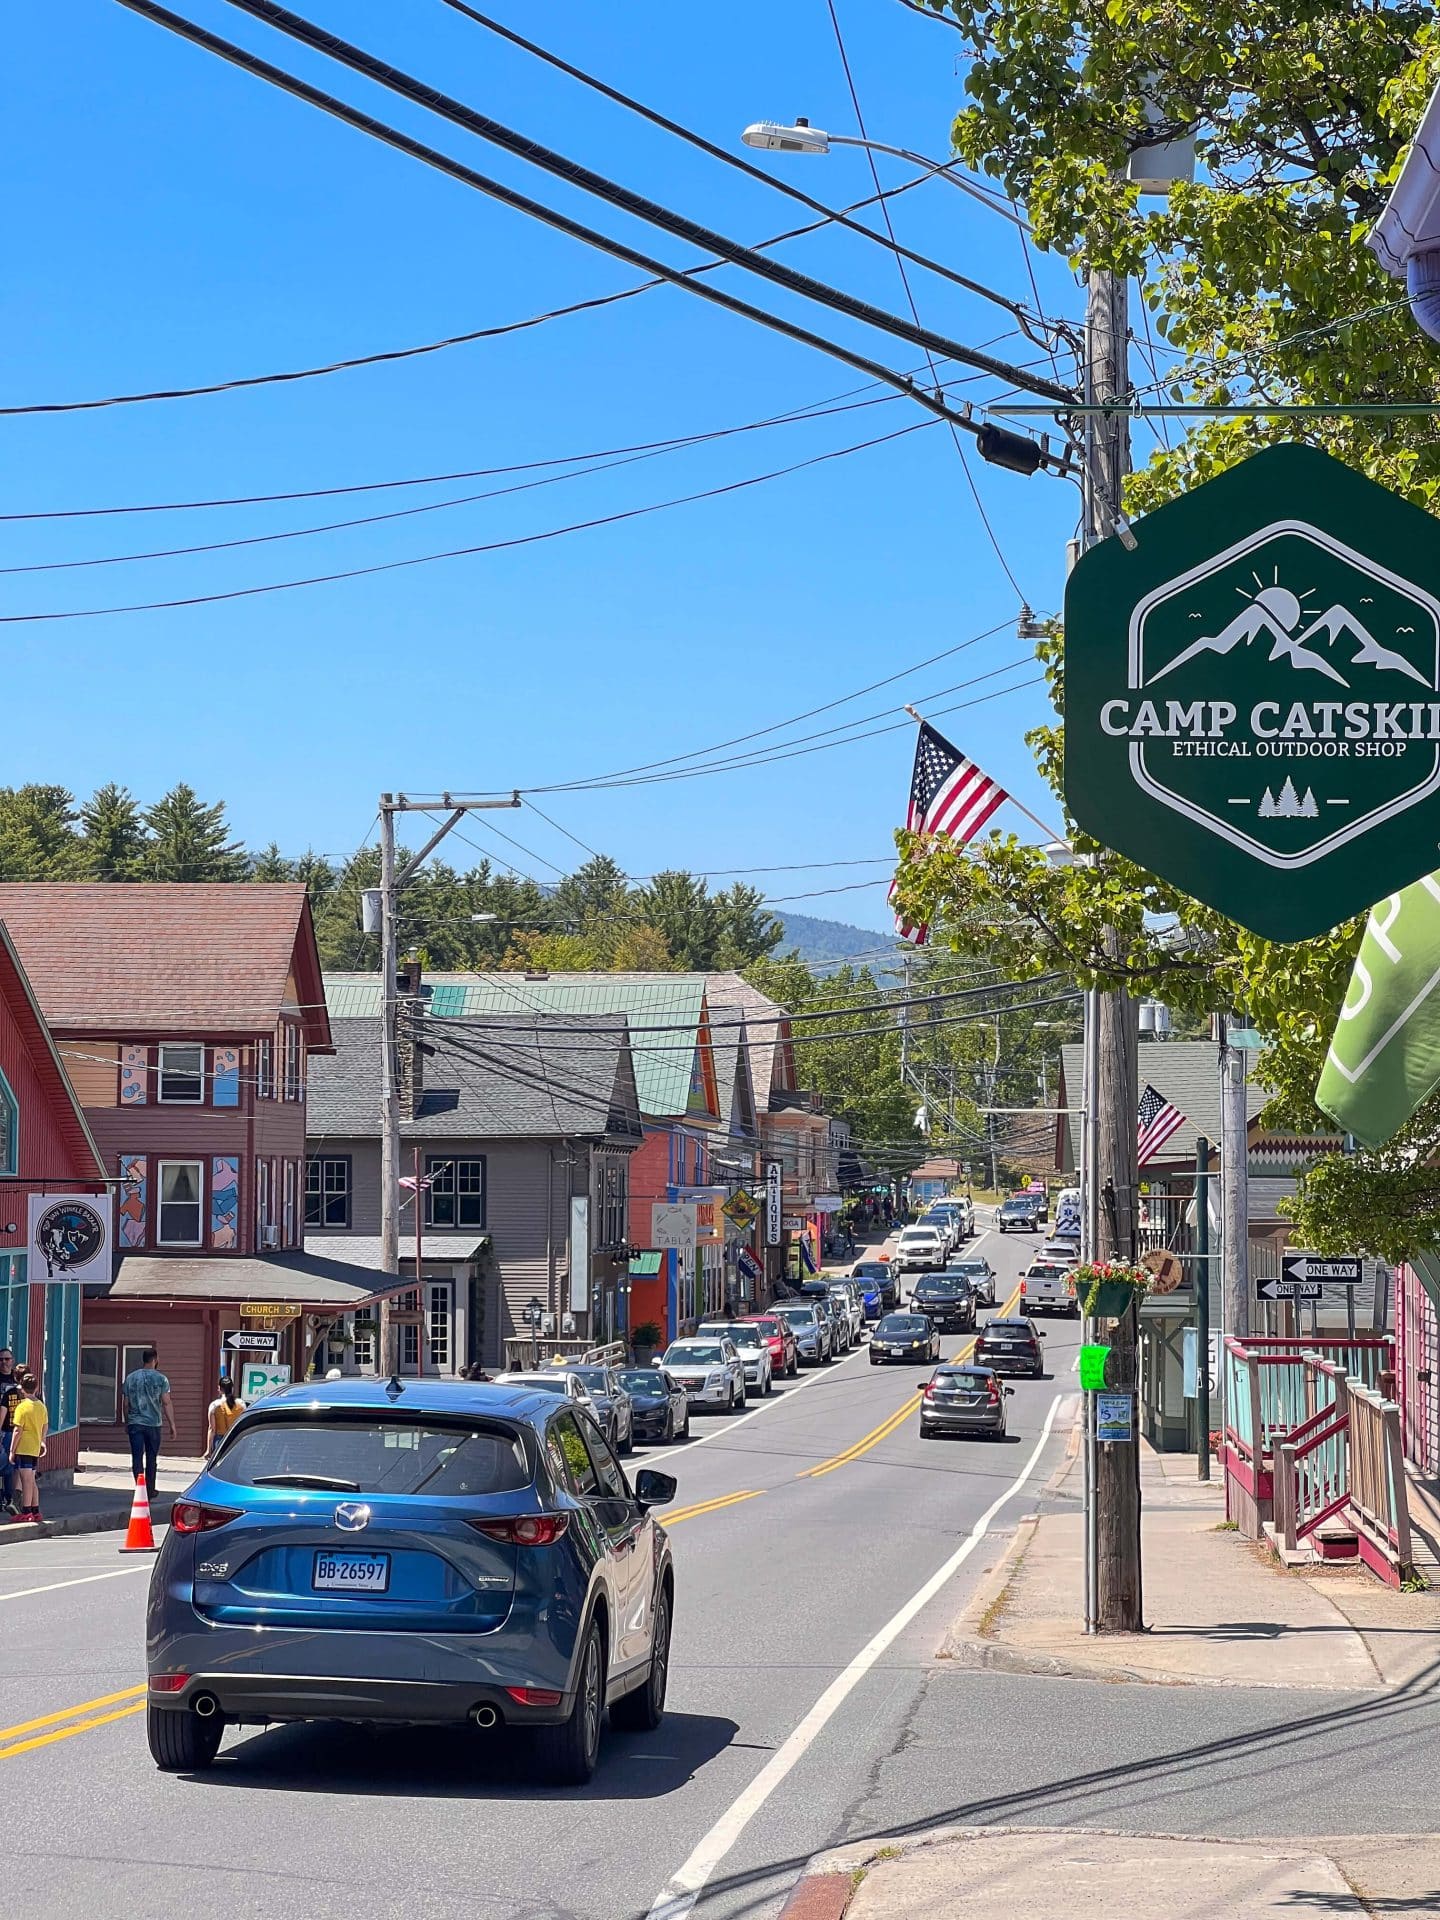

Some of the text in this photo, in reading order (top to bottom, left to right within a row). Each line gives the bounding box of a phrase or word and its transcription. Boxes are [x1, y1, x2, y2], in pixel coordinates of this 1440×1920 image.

[1099, 699, 1237, 737] CAMP
[1172, 741, 1407, 758] ETHICAL OUTDOOR SHOP
[770, 1165, 778, 1243] ANTIQUES
[656, 1236, 692, 1245] TABLA
[1306, 1264, 1355, 1276] ONE WAY
[1276, 1284, 1295, 1294] ONE
[246, 1305, 280, 1314] CHURCH
[239, 1336, 274, 1345] ONE WAY
